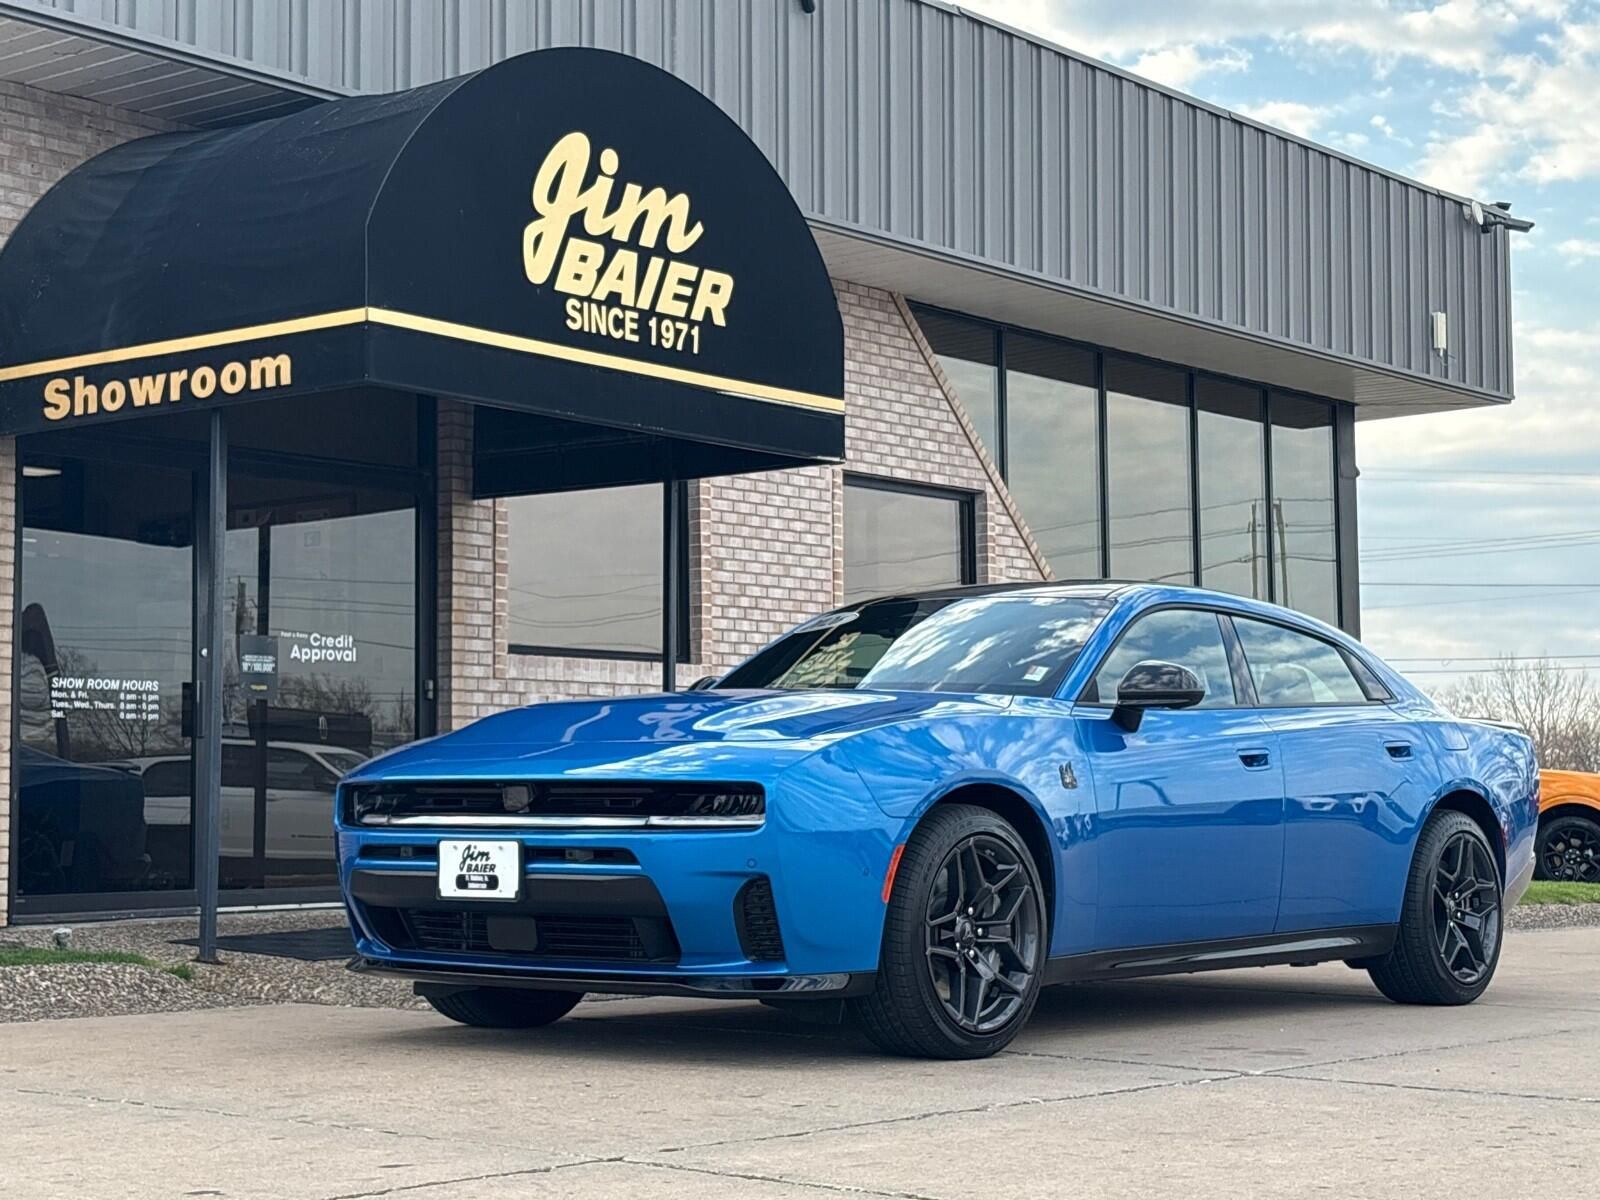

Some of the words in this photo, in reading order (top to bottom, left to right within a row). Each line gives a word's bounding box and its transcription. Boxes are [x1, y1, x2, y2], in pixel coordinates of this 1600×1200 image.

[523, 131, 704, 285] Jim
[553, 237, 734, 327] BAIER
[565, 298, 640, 342] SINCE
[648, 316, 700, 354] 1971
[43, 353, 292, 420] Showroom
[309, 633, 353, 648] Credit
[290, 644, 357, 663] Approval
[51, 677, 85, 689] SHOW
[86, 678, 120, 690] ROOM
[121, 680, 159, 691] HOURS
[51, 690, 69, 699] Mon.
[70, 691, 76, 699] &
[125, 693, 137, 701] am
[147, 694, 159, 702] pm
[93, 701, 116, 710] Thurs.
[147, 703, 159, 712] pm
[51, 710, 66, 719] Sat.
[147, 713, 159, 721] pm
[459, 844, 491, 872] Jim
[466, 863, 497, 873] BAIER
